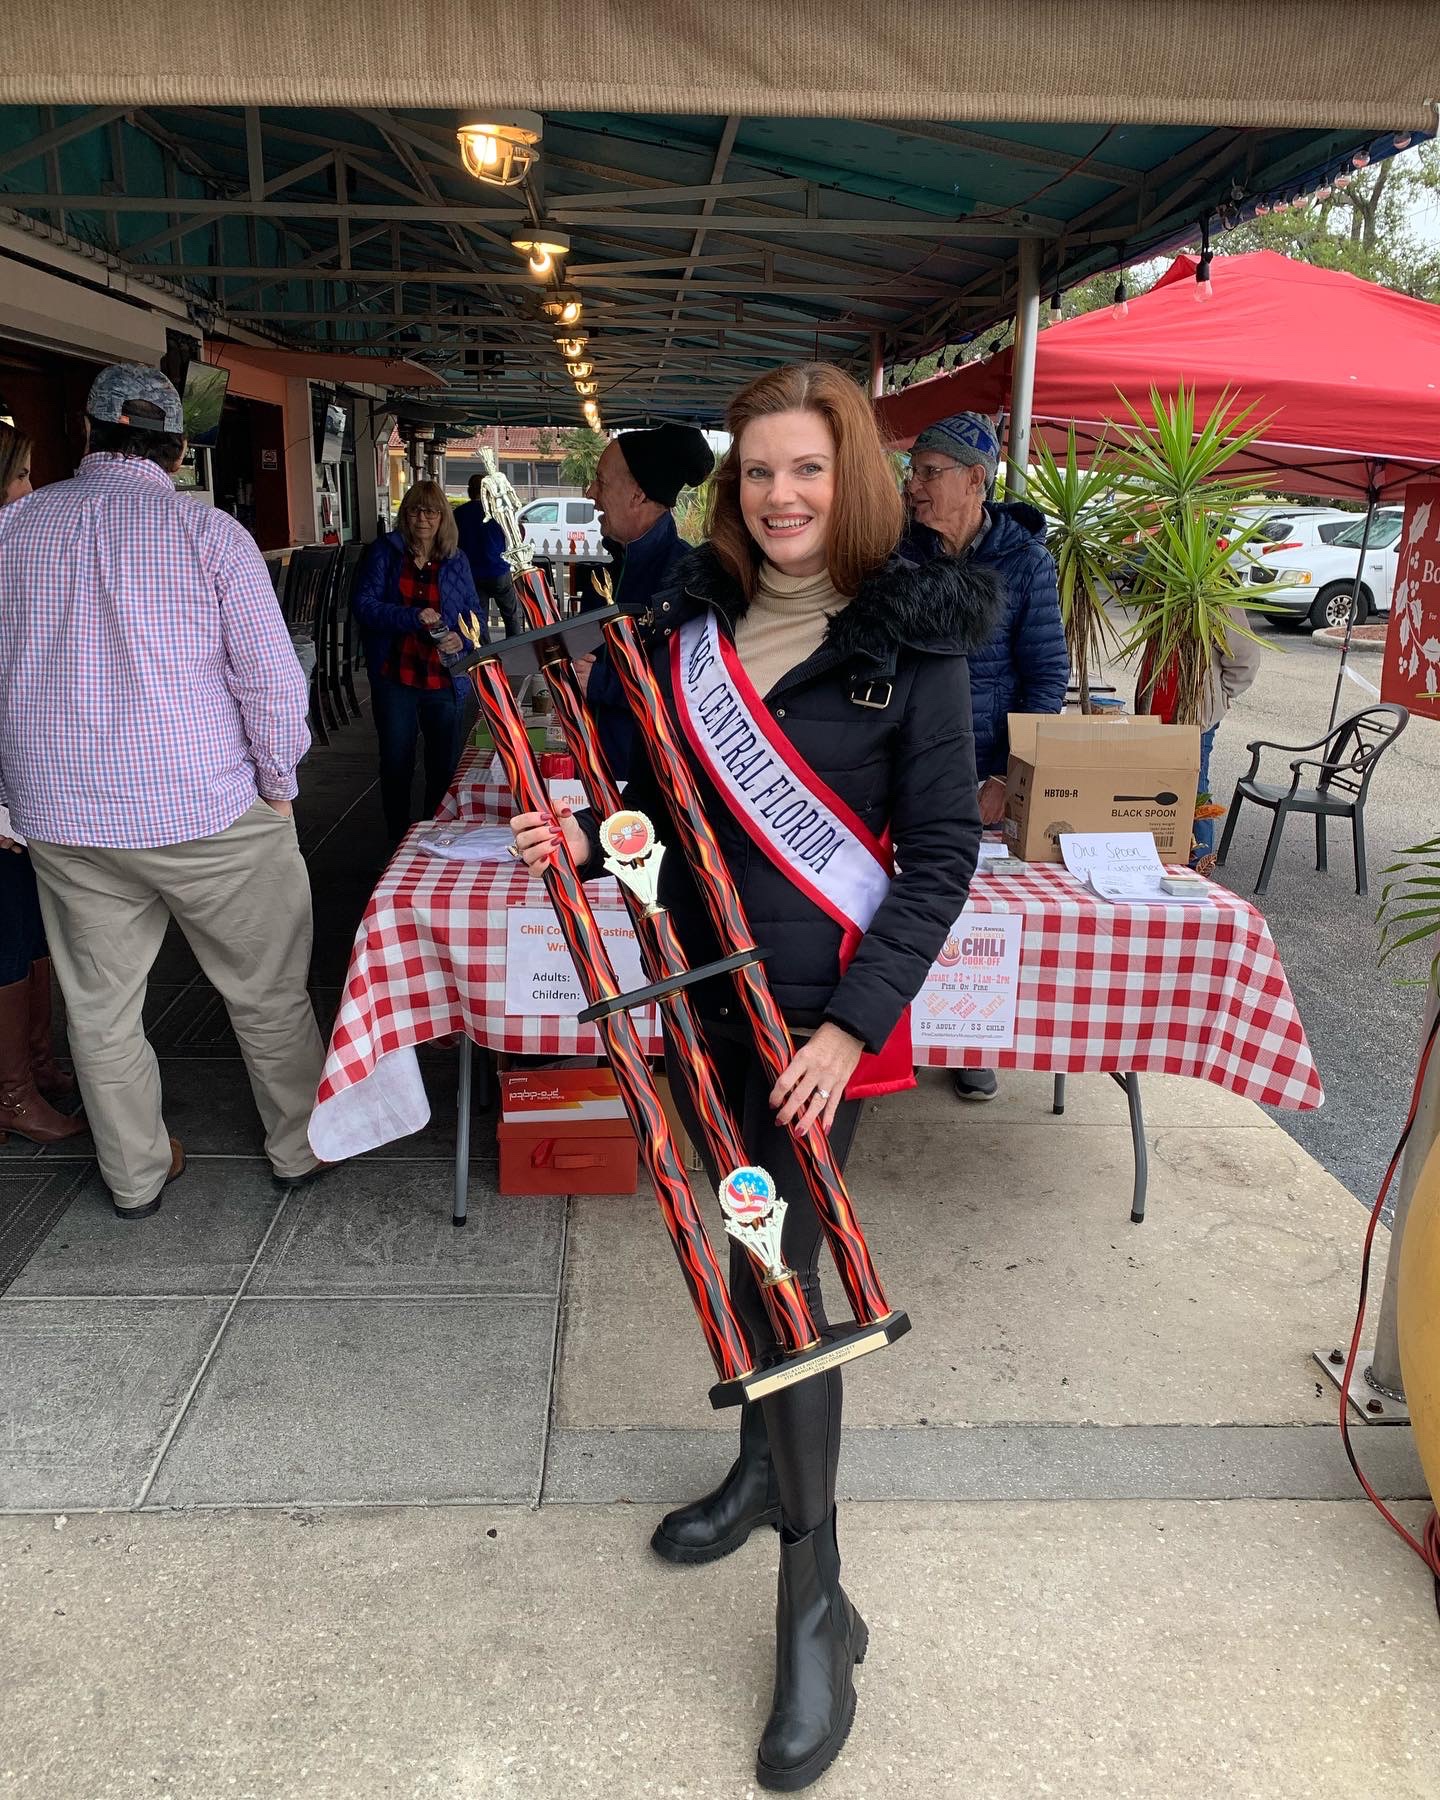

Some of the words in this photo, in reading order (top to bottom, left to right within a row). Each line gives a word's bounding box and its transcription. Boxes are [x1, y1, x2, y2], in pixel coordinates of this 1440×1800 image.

[698, 683, 774, 792] CENTRAL
[750, 775, 846, 875] FLORIDA
[1044, 789, 1078, 798] HBT09-R
[562, 795, 584, 804] Chili
[1111, 809, 1143, 818] BLACK
[1144, 809, 1177, 818] SPOON
[1072, 843, 1098, 858] One
[1106, 843, 1147, 859] Spoon
[520, 925, 543, 935] Chili
[962, 938, 1006, 957] CHILI
[962, 956, 1000, 966] COOK-OFF
[532, 973, 570, 982] Adults:
[532, 990, 580, 1000] Children:
